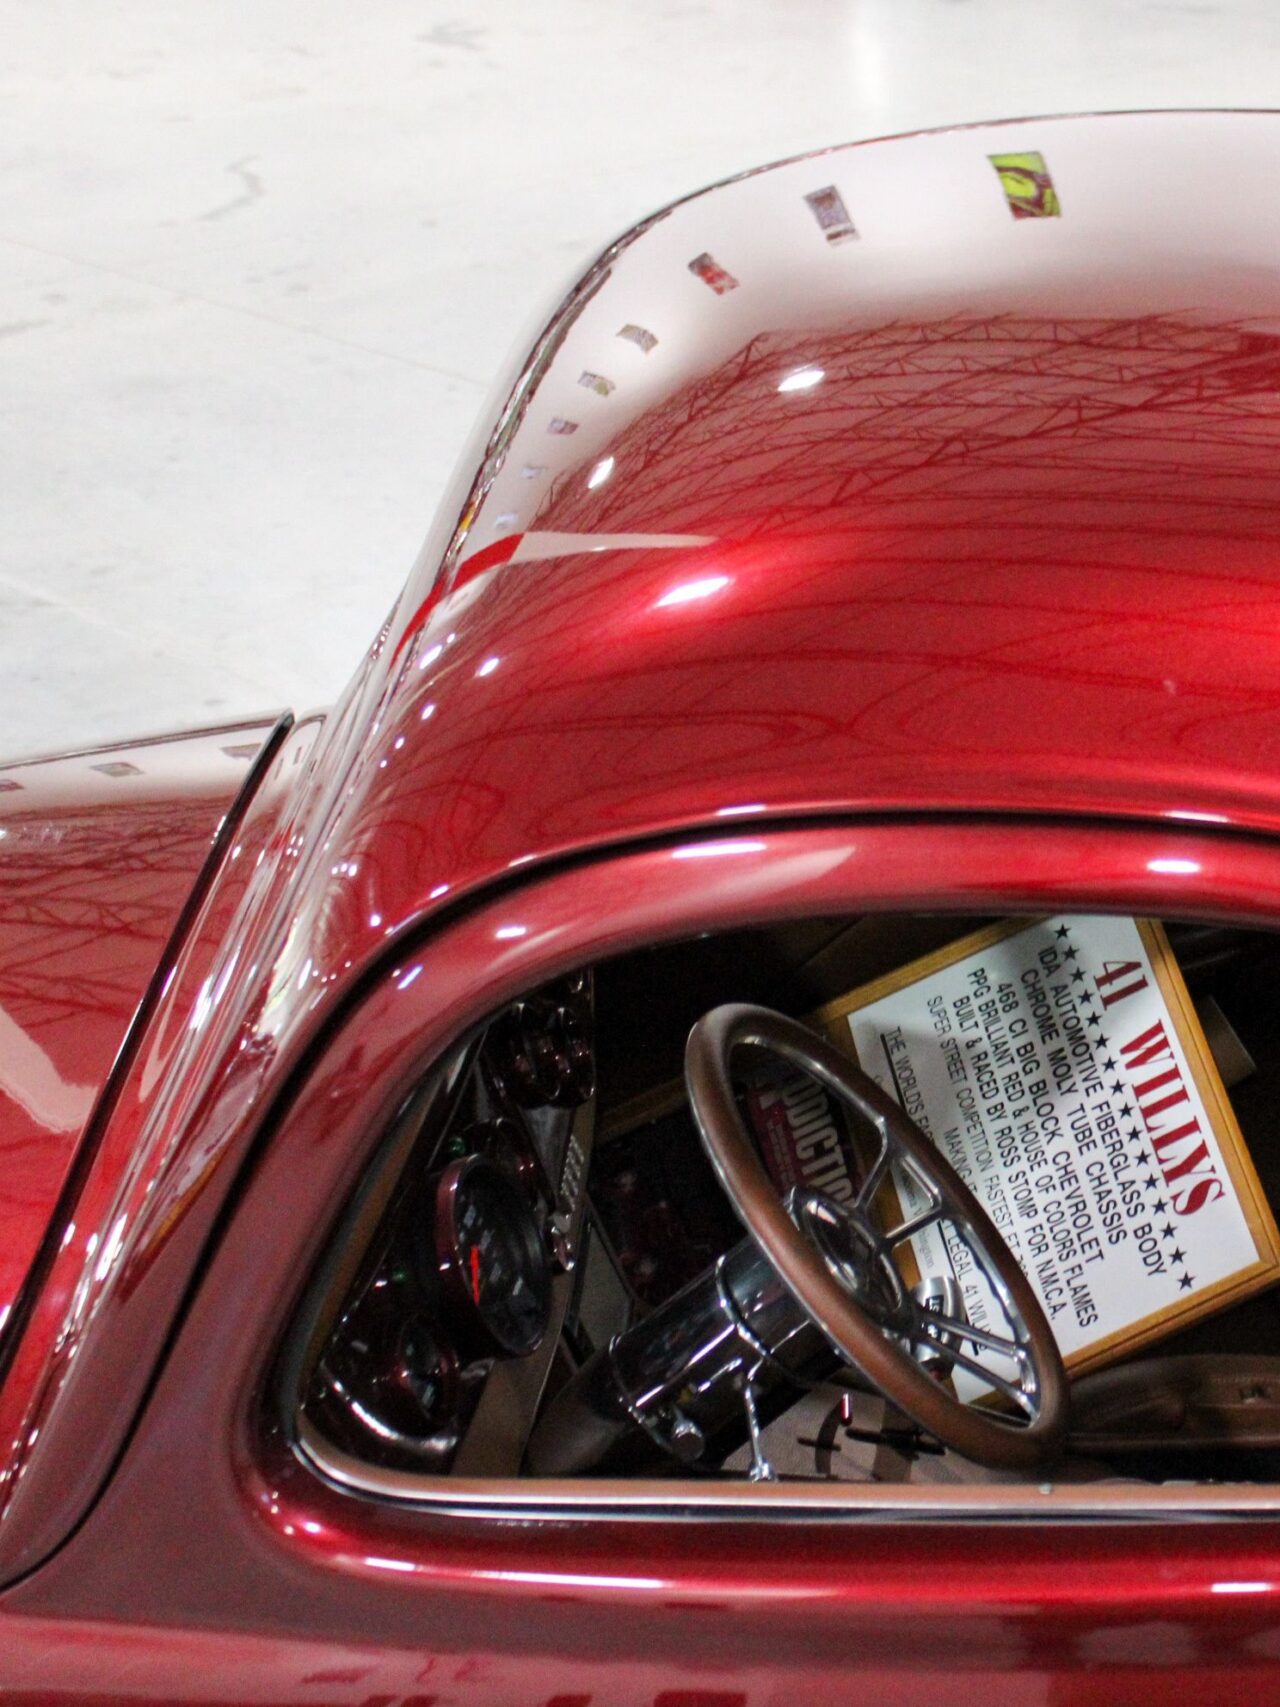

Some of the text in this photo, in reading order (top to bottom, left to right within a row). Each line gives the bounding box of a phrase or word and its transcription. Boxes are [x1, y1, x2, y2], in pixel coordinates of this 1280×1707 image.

[953, 995, 979, 1032] BUILT
[886, 1026, 906, 1055] THE
[965, 1037, 983, 1050] &
[971, 1051, 999, 1099] RACED
[1094, 961, 1225, 1215] 41 WILLYS
[927, 995, 951, 1037] SUPER
[940, 1038, 967, 1084] STREET
[956, 1088, 995, 1172] COMPETITION
[984, 1174, 1014, 1230] FASTEST
[986, 1102, 1008, 1122] BY
[996, 983, 1104, 1263] 468 CI BIG BLOCK CHEVROLET
[1021, 969, 1127, 1244] CHROME MOLY TUBE CHASSIS
[1038, 946, 1167, 1276] IDA AUTOMOTIVE FIBERGLASS BODY
[943, 1127, 972, 1179] MAKING
[967, 967, 1098, 1327] PPG BRILLIANT RED & HOUSE OF COLORS FLAMES
[994, 1125, 1021, 1168] ROSS
[1008, 1171, 1038, 1219] STOMP
[1025, 1224, 1049, 1258] FOR
[948, 1236, 973, 1280] LEGAL
[963, 1284, 978, 1299] 41
